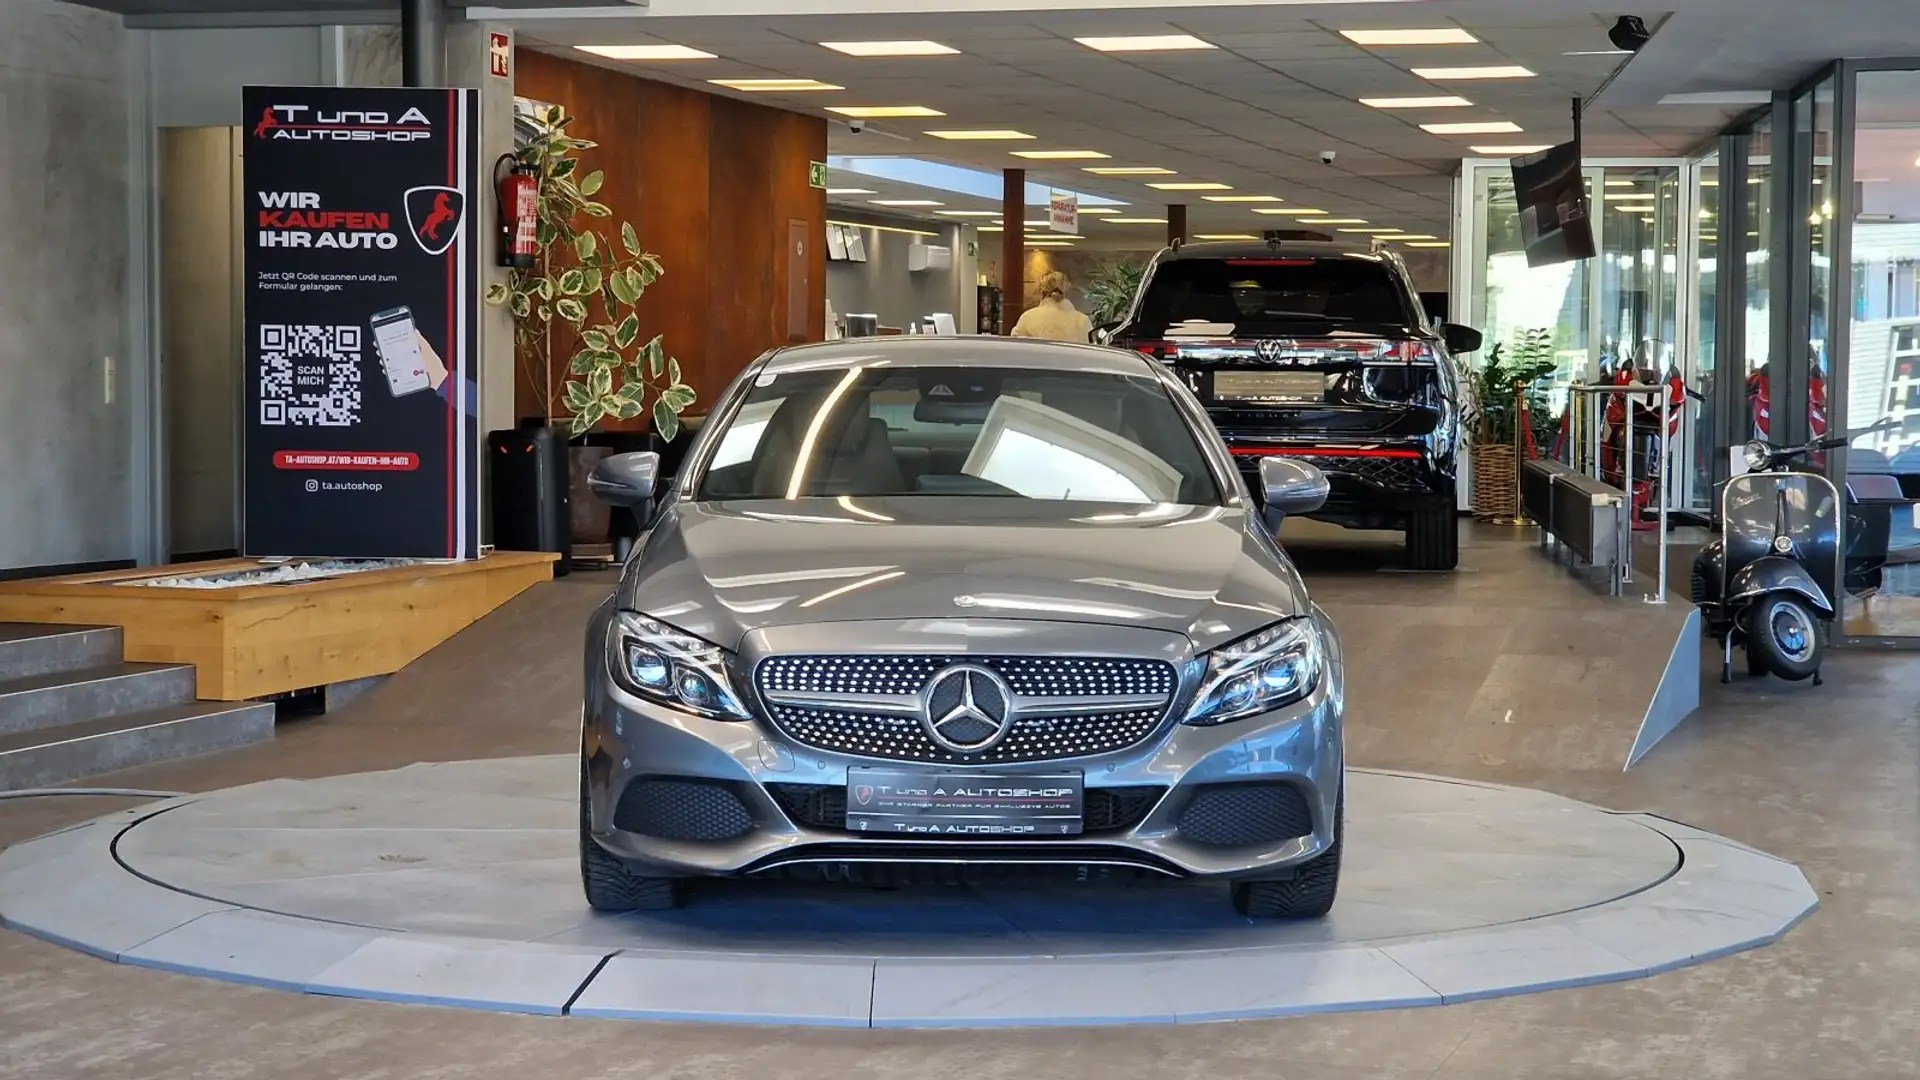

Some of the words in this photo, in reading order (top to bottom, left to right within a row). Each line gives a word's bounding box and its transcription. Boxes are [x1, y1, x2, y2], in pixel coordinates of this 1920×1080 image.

[273, 105, 308, 122] T
[396, 106, 431, 124] A
[272, 129, 431, 141] AUTOSHOP
[258, 191, 320, 209] WIR
[259, 211, 389, 229] KAUFEN
[259, 231, 312, 248] IHR
[314, 232, 398, 249] AUTO
[258, 272, 279, 280] Jetzt
[281, 272, 295, 281] QR
[297, 272, 319, 281] Code
[259, 282, 298, 290] Formular
[297, 366, 324, 375] SCAN
[297, 376, 324, 386] MICH
[322, 481, 383, 492] ta.autoshop
[876, 785, 892, 794] T
[933, 788, 947, 796] A
[953, 788, 1073, 797] AUTOSHOP
[946, 825, 1035, 833] AUTOSHOP
